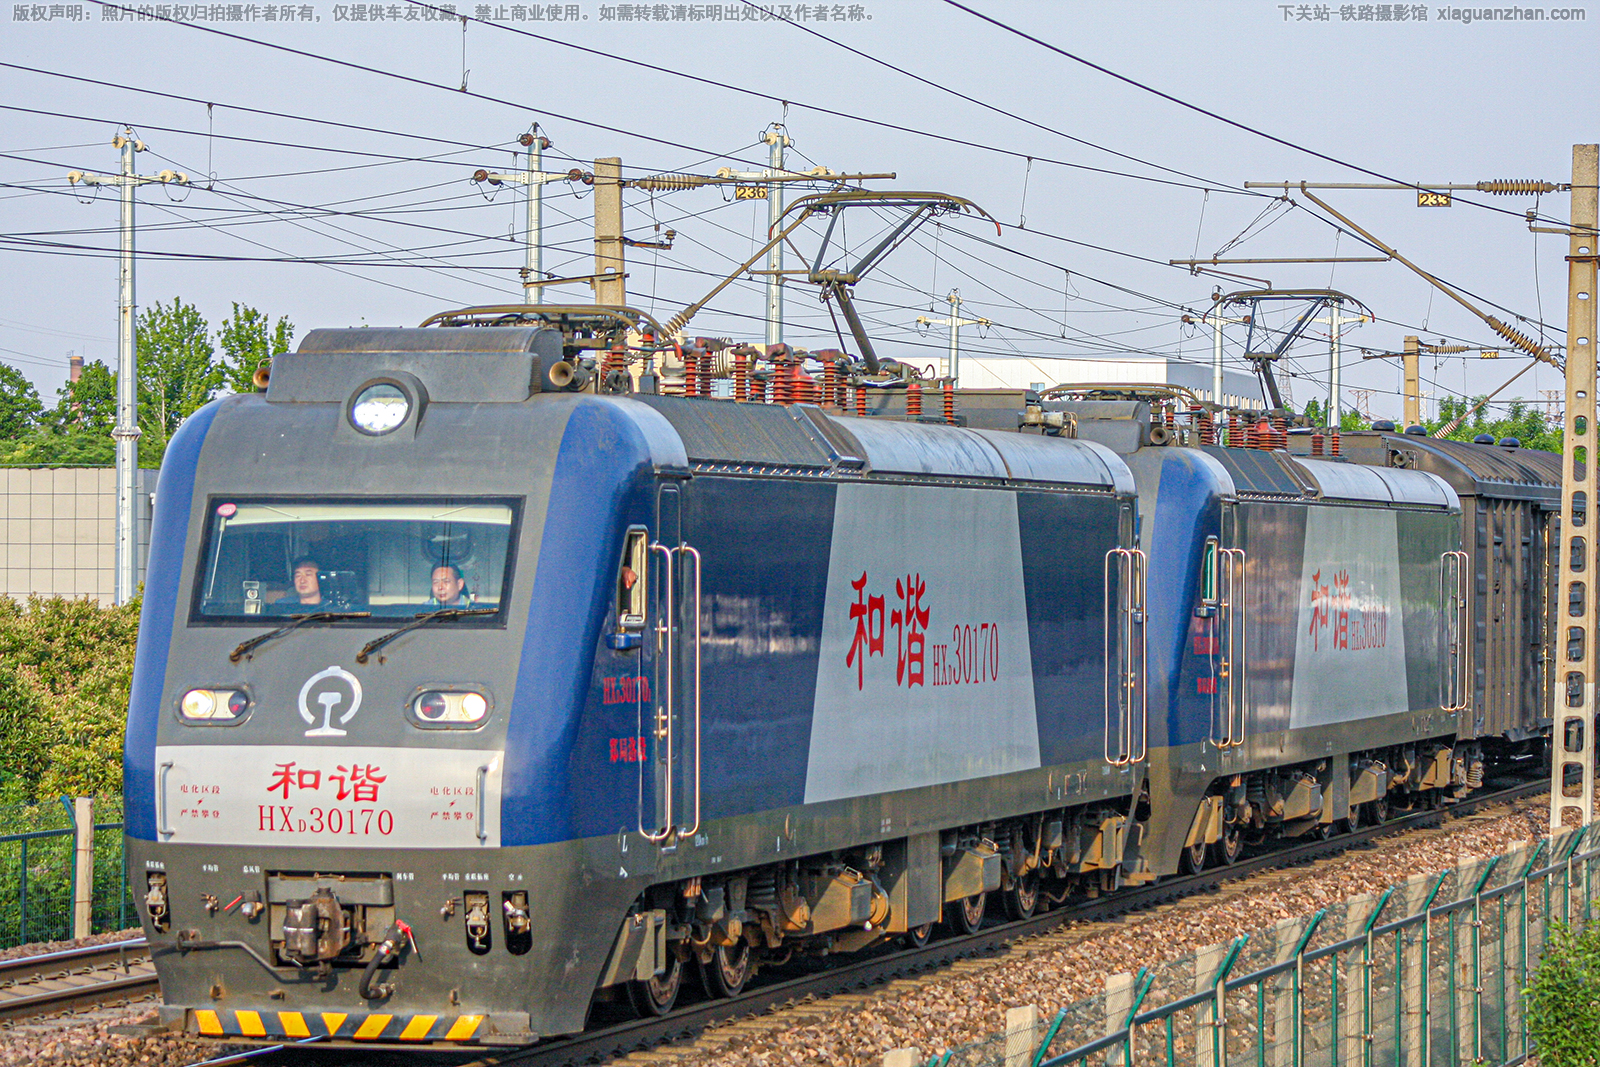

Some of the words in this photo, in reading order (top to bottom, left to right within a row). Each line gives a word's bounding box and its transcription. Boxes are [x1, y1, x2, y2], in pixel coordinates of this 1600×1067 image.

[737, 186, 766, 199] 236
[1420, 194, 1450, 206] 233
[1309, 568, 1352, 652] 和谐
[846, 570, 931, 691] 和谐
[266, 761, 388, 803] 和谐
[180, 784, 220, 795] 电化区段
[430, 786, 474, 796] 电化区段
[180, 808, 221, 819] 严禁攀登
[430, 811, 474, 821] 严禁攀登
